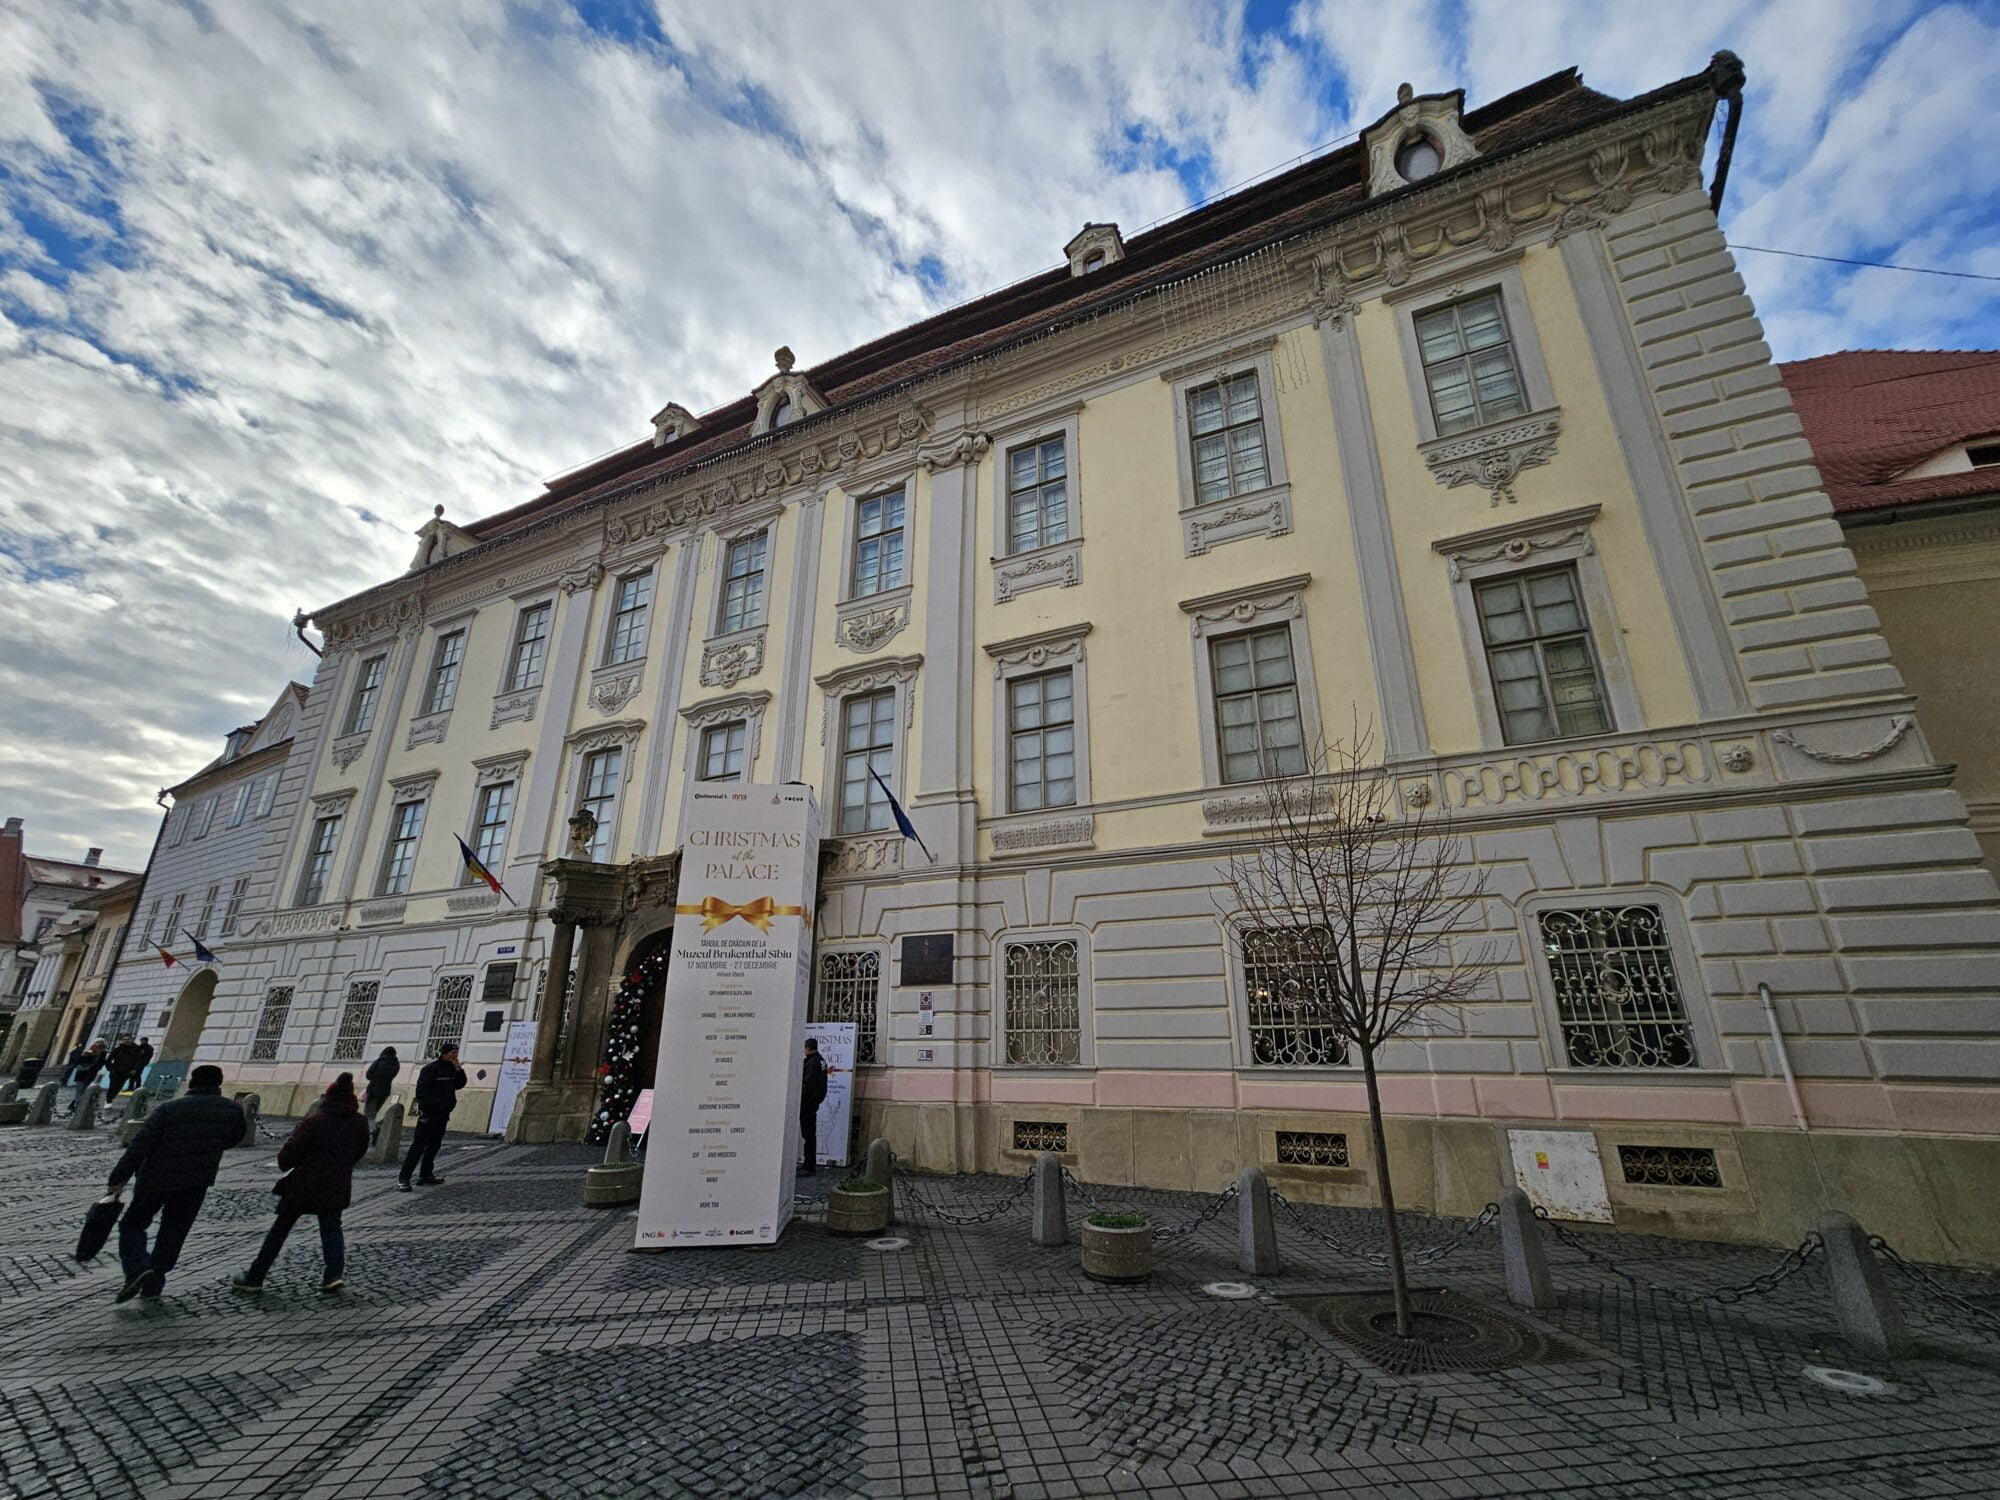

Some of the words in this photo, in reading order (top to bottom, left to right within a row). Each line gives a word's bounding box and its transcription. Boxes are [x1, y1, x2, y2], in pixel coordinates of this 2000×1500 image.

[690, 831, 800, 848] CHRISTMAS
[742, 849, 755, 861] the
[706, 864, 778, 880] PALACE
[677, 949, 711, 959] Muzeul
[713, 949, 767, 959] Brukenthal
[768, 949, 792, 959] Sibiu
[687, 961, 694, 969] 17
[695, 961, 728, 969] NOIEMBRIE
[734, 961, 741, 969] 27
[744, 961, 778, 969] DECEMBRIE
